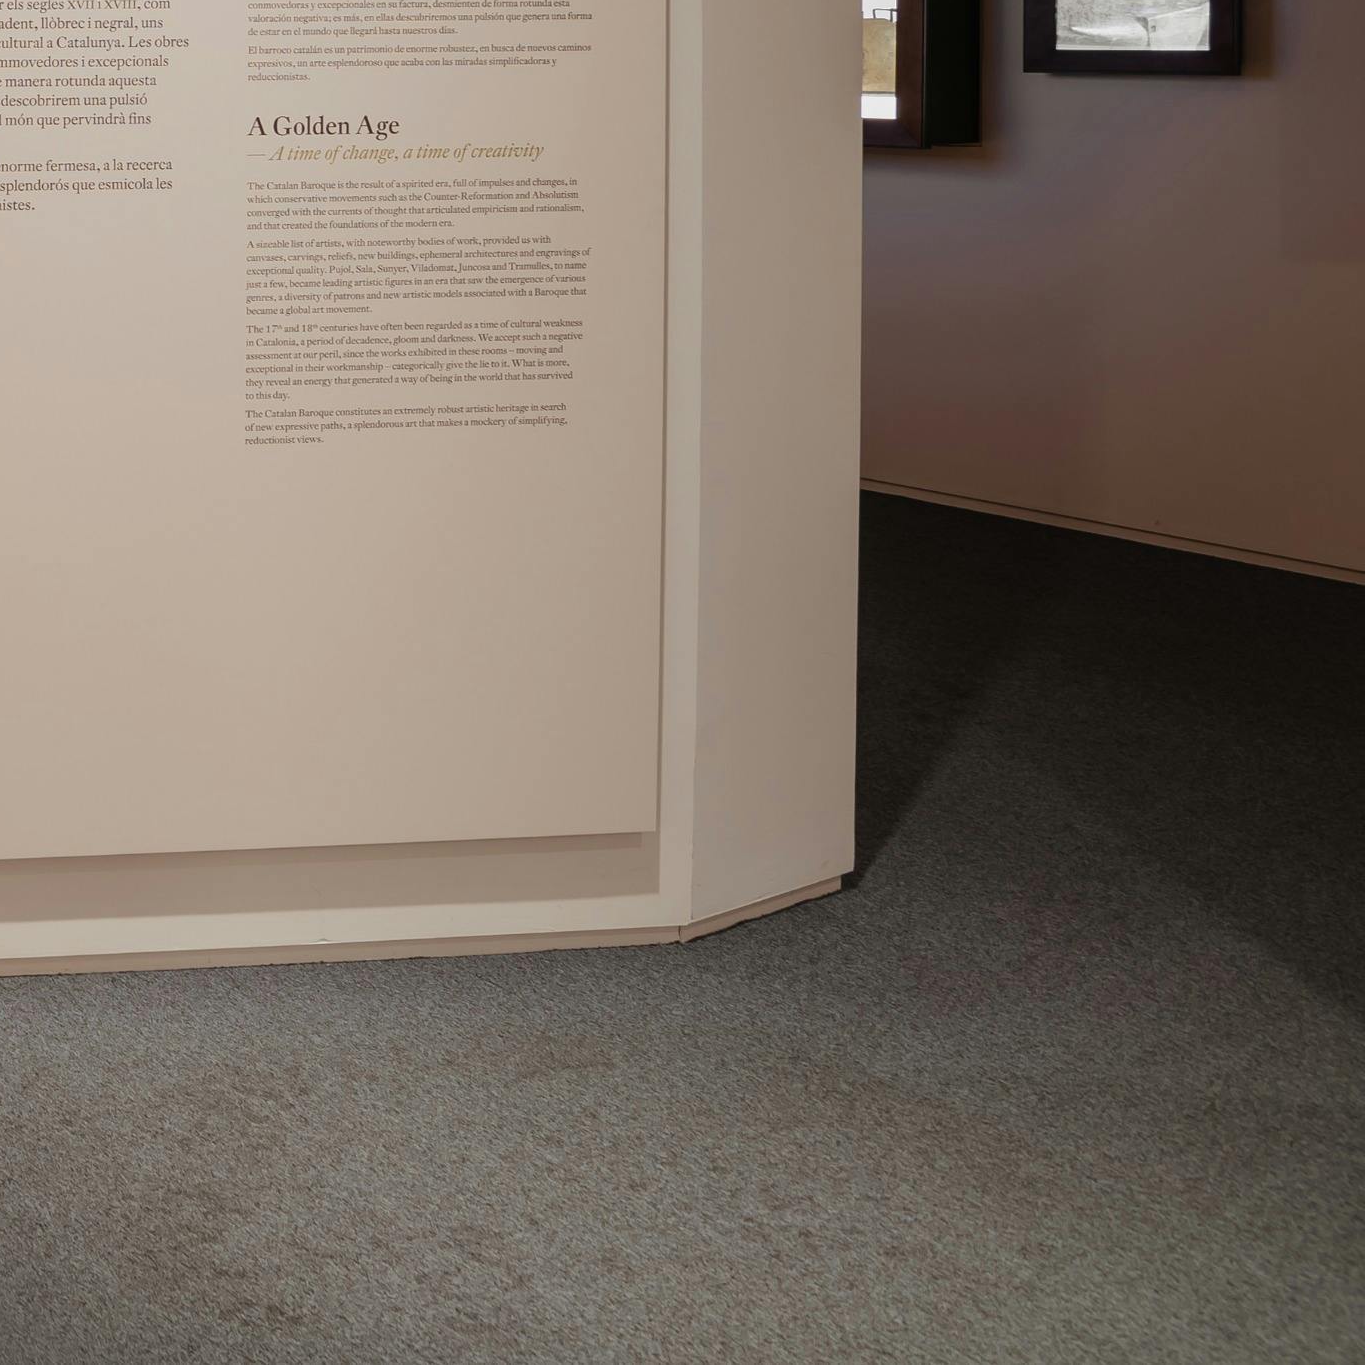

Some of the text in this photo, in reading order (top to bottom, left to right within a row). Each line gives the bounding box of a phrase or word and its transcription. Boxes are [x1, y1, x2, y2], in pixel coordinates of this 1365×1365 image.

[247, 115, 400, 140] A Golden Age
[286, 146, 325, 161] time
[324, 145, 343, 164] of
[342, 144, 399, 164] change,
[413, 145, 453, 159] time
[450, 144, 472, 163] of
[469, 144, 545, 163] creativity
[46, 159, 100, 174] fermesa,
[112, 159, 124, 172] la
[126, 162, 173, 172] recerca
[72, 181, 96, 195] que
[97, 177, 154, 191] esmicola
[155, 177, 173, 190] les
